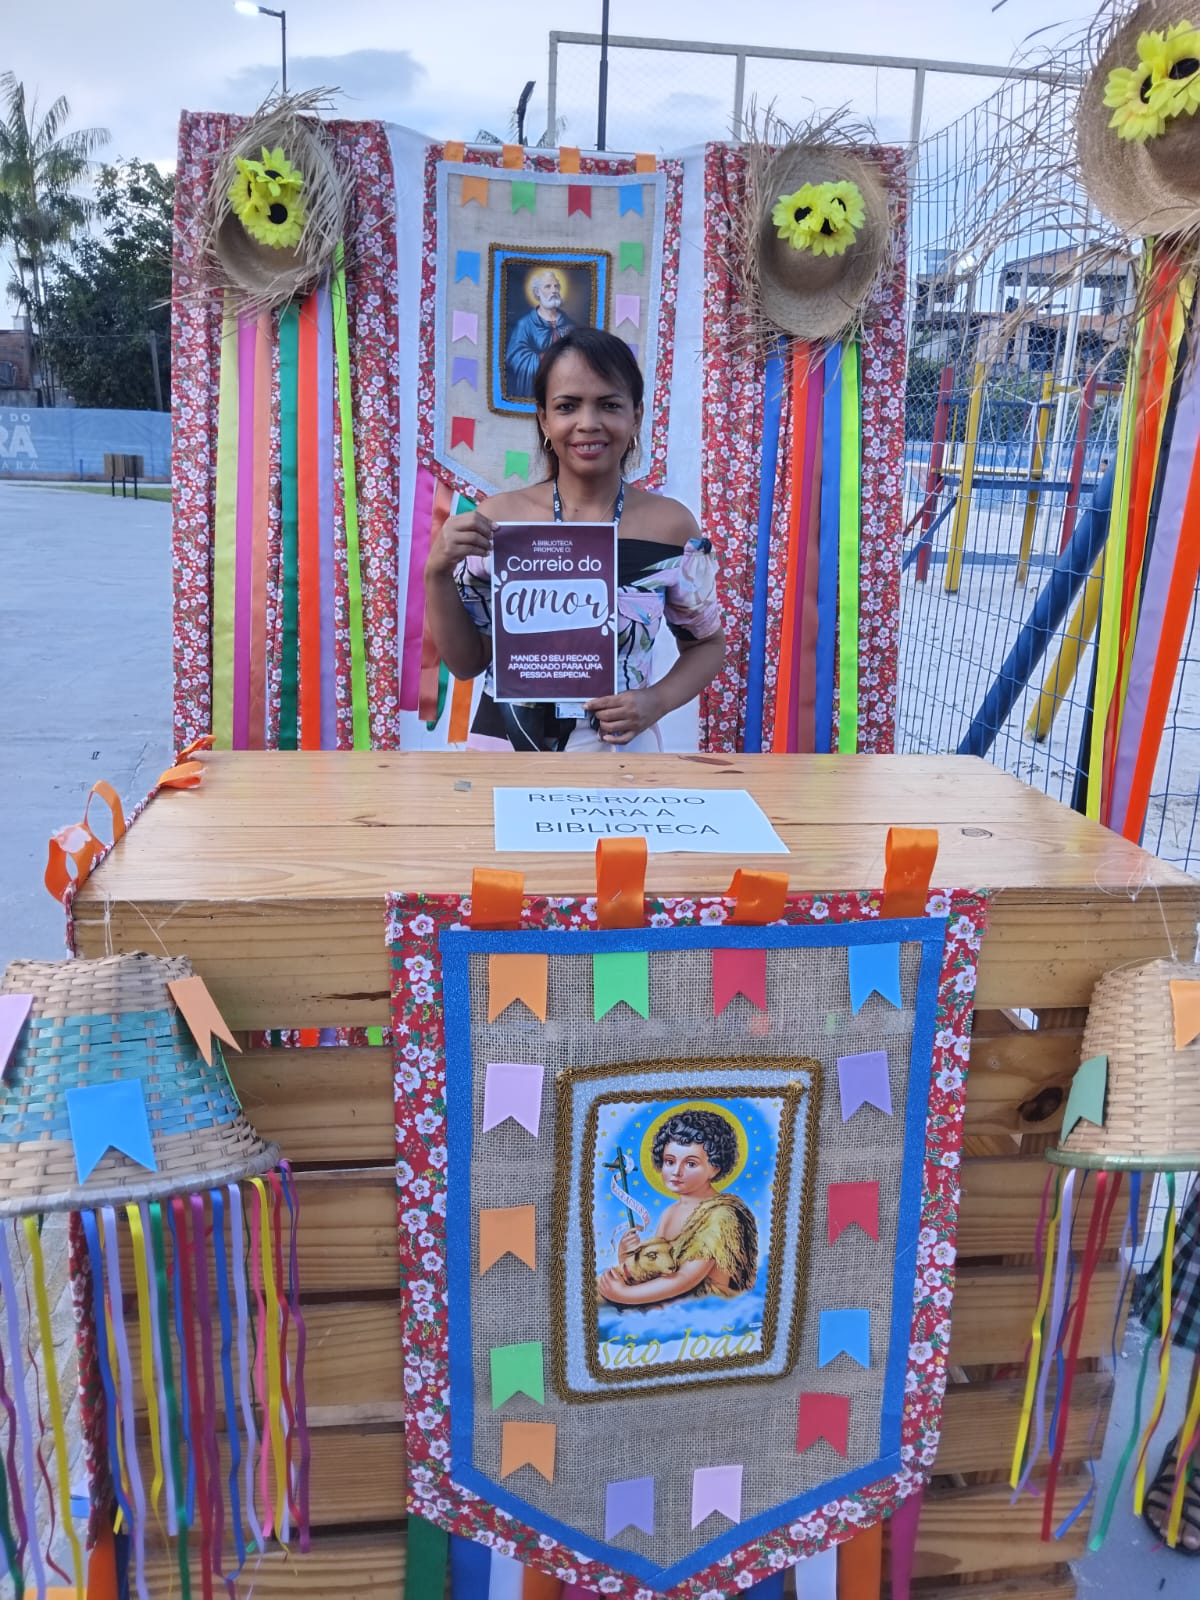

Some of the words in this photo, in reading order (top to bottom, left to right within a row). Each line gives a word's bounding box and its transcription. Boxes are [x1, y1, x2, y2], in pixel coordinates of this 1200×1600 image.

[10, 413, 30, 422] DO
[506, 555, 574, 572] Correio
[578, 555, 602, 572] do
[505, 587, 609, 623] amor
[510, 654, 539, 662] MANDE
[540, 654, 548, 662] O
[548, 654, 565, 662] SEU
[566, 654, 600, 662] RECADO
[528, 793, 705, 805] RESERVADO
[570, 808, 648, 817] PARA
[656, 808, 676, 817] A
[535, 821, 721, 835] BIBLIOTECA
[602, 1333, 661, 1367] São
[676, 1325, 757, 1361] João
